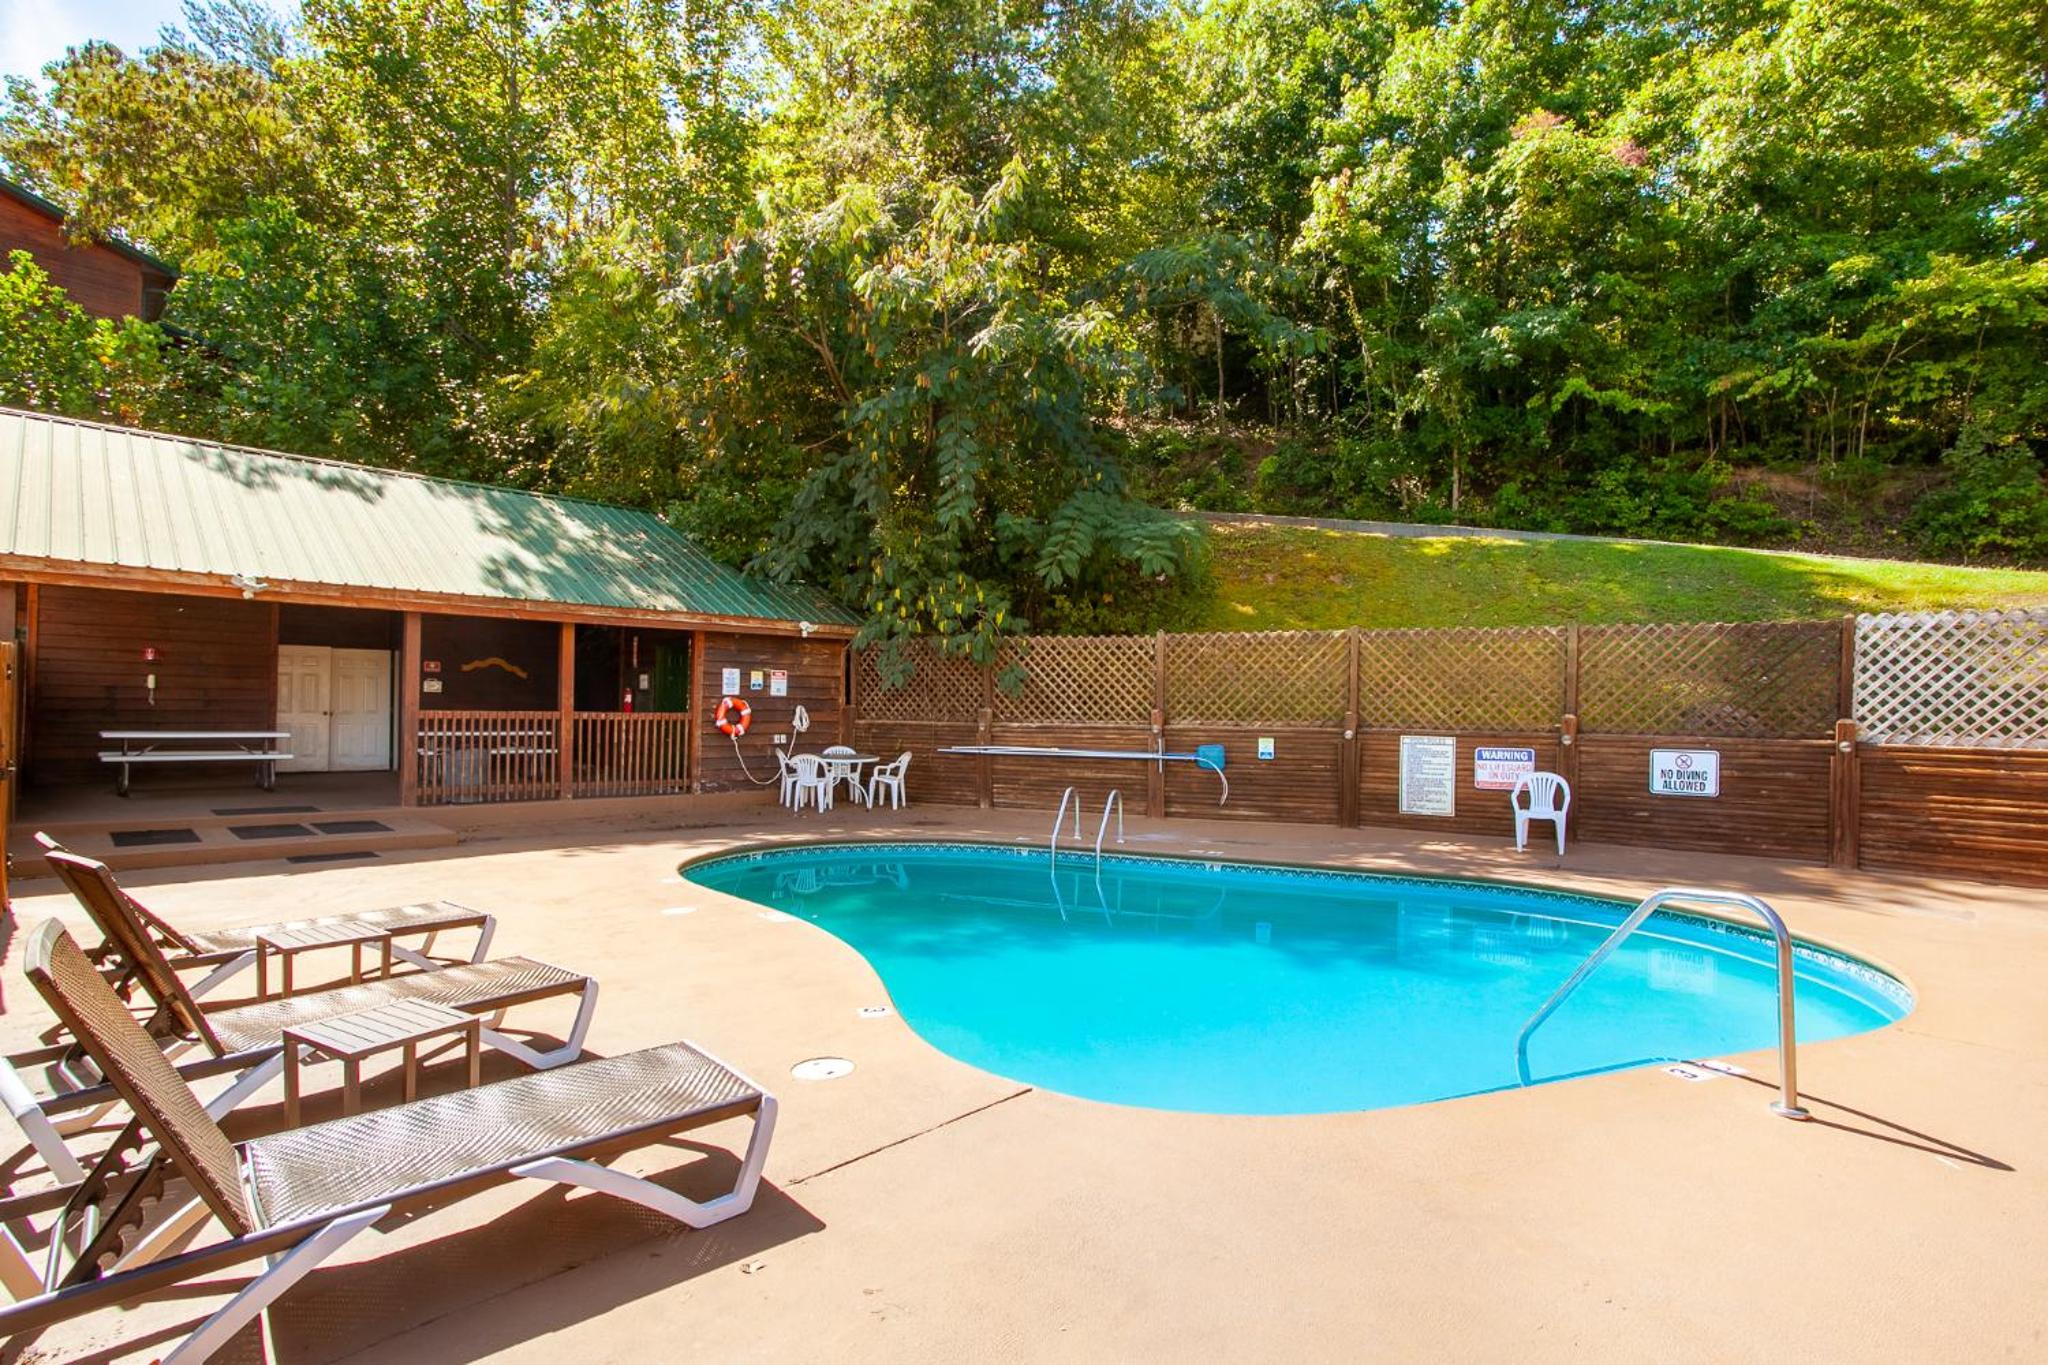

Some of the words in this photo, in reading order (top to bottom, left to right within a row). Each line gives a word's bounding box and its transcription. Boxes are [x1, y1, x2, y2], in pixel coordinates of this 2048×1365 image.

[1482, 750, 1529, 760] WARNING
[1660, 769, 1673, 779] NO
[1676, 769, 1708, 781] DIVING
[1663, 780, 1706, 792] ALLOWED
